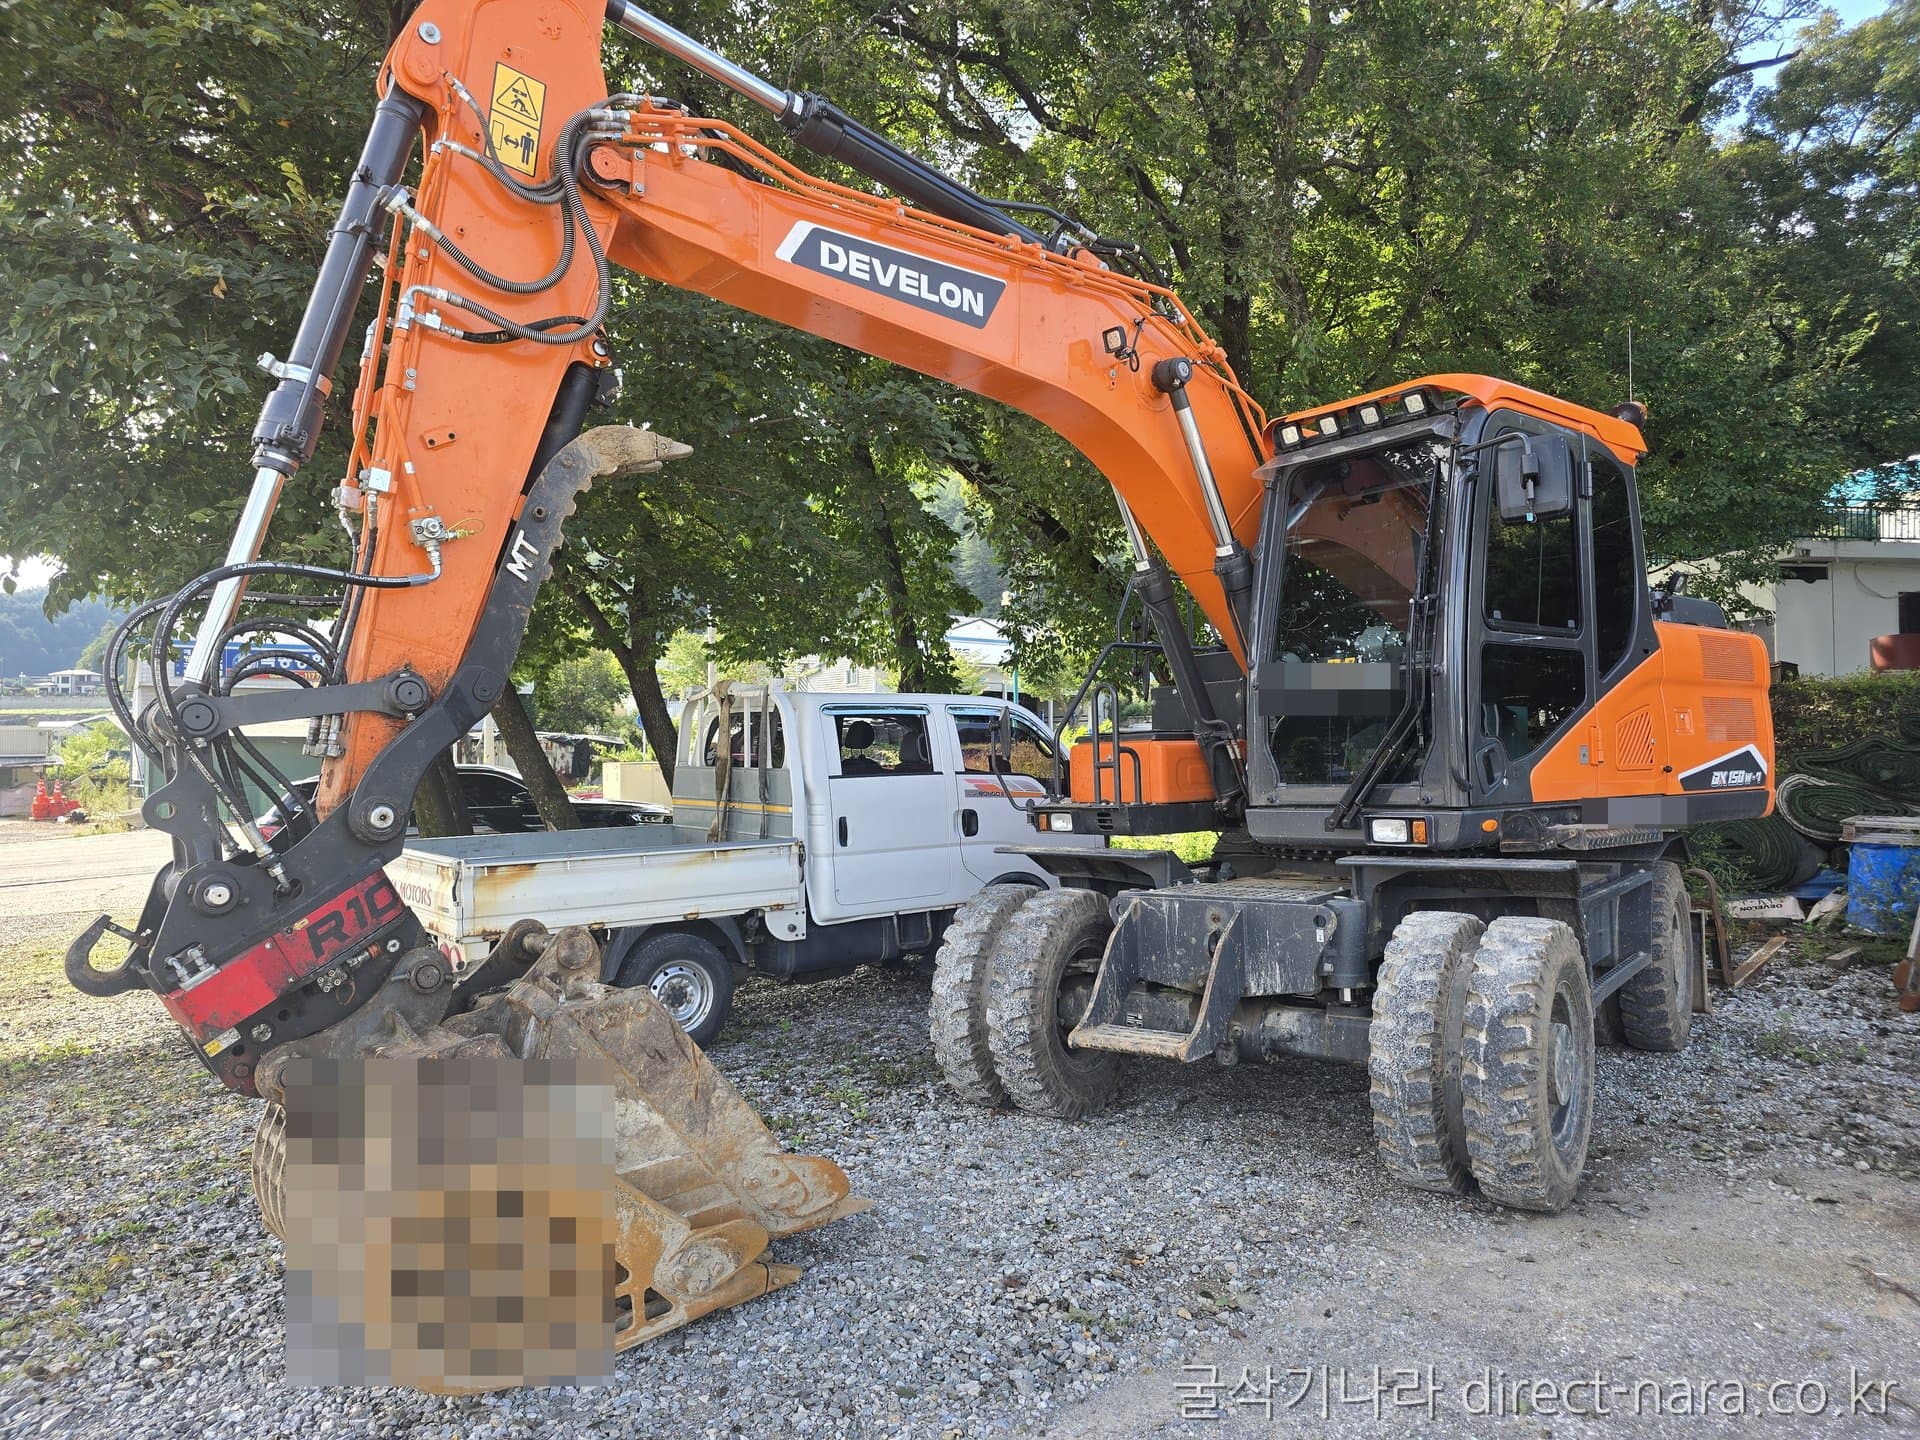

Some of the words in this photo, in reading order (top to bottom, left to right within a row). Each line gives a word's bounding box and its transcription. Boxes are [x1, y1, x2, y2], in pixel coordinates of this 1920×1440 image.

[820, 240, 984, 317] DEVELON
[506, 529, 539, 582] MT
[306, 878, 400, 959] R10
[1739, 903, 1783, 912] DEVELON
